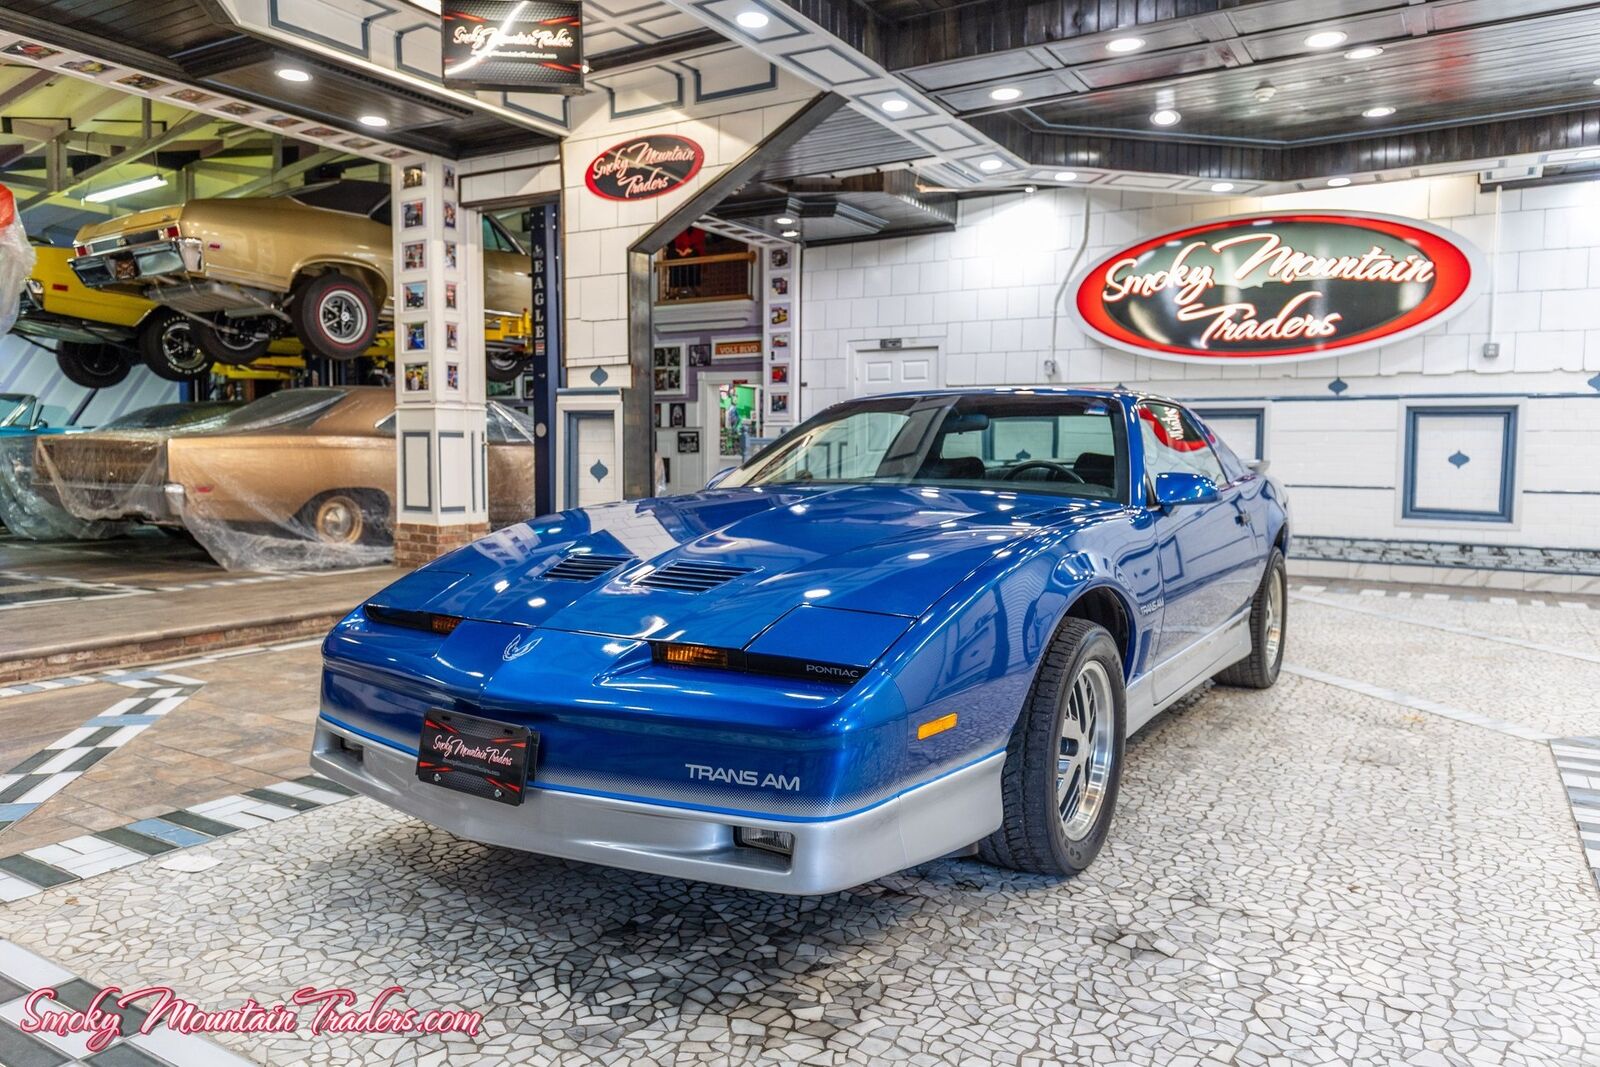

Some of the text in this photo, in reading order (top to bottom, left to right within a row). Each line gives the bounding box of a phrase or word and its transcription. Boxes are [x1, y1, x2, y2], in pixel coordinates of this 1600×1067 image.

[592, 141, 695, 180] Smoky Mountain
[617, 167, 670, 198] Traders
[1101, 232, 1436, 306] Smoky Mountain
[533, 260, 545, 339] EAGLE
[1177, 291, 1342, 350] Traders
[805, 664, 860, 678] PONTIAC
[432, 734, 454, 758] Smoky
[451, 738, 488, 761] Mountain
[485, 746, 513, 767] Traders
[685, 763, 800, 792] TRANS AM
